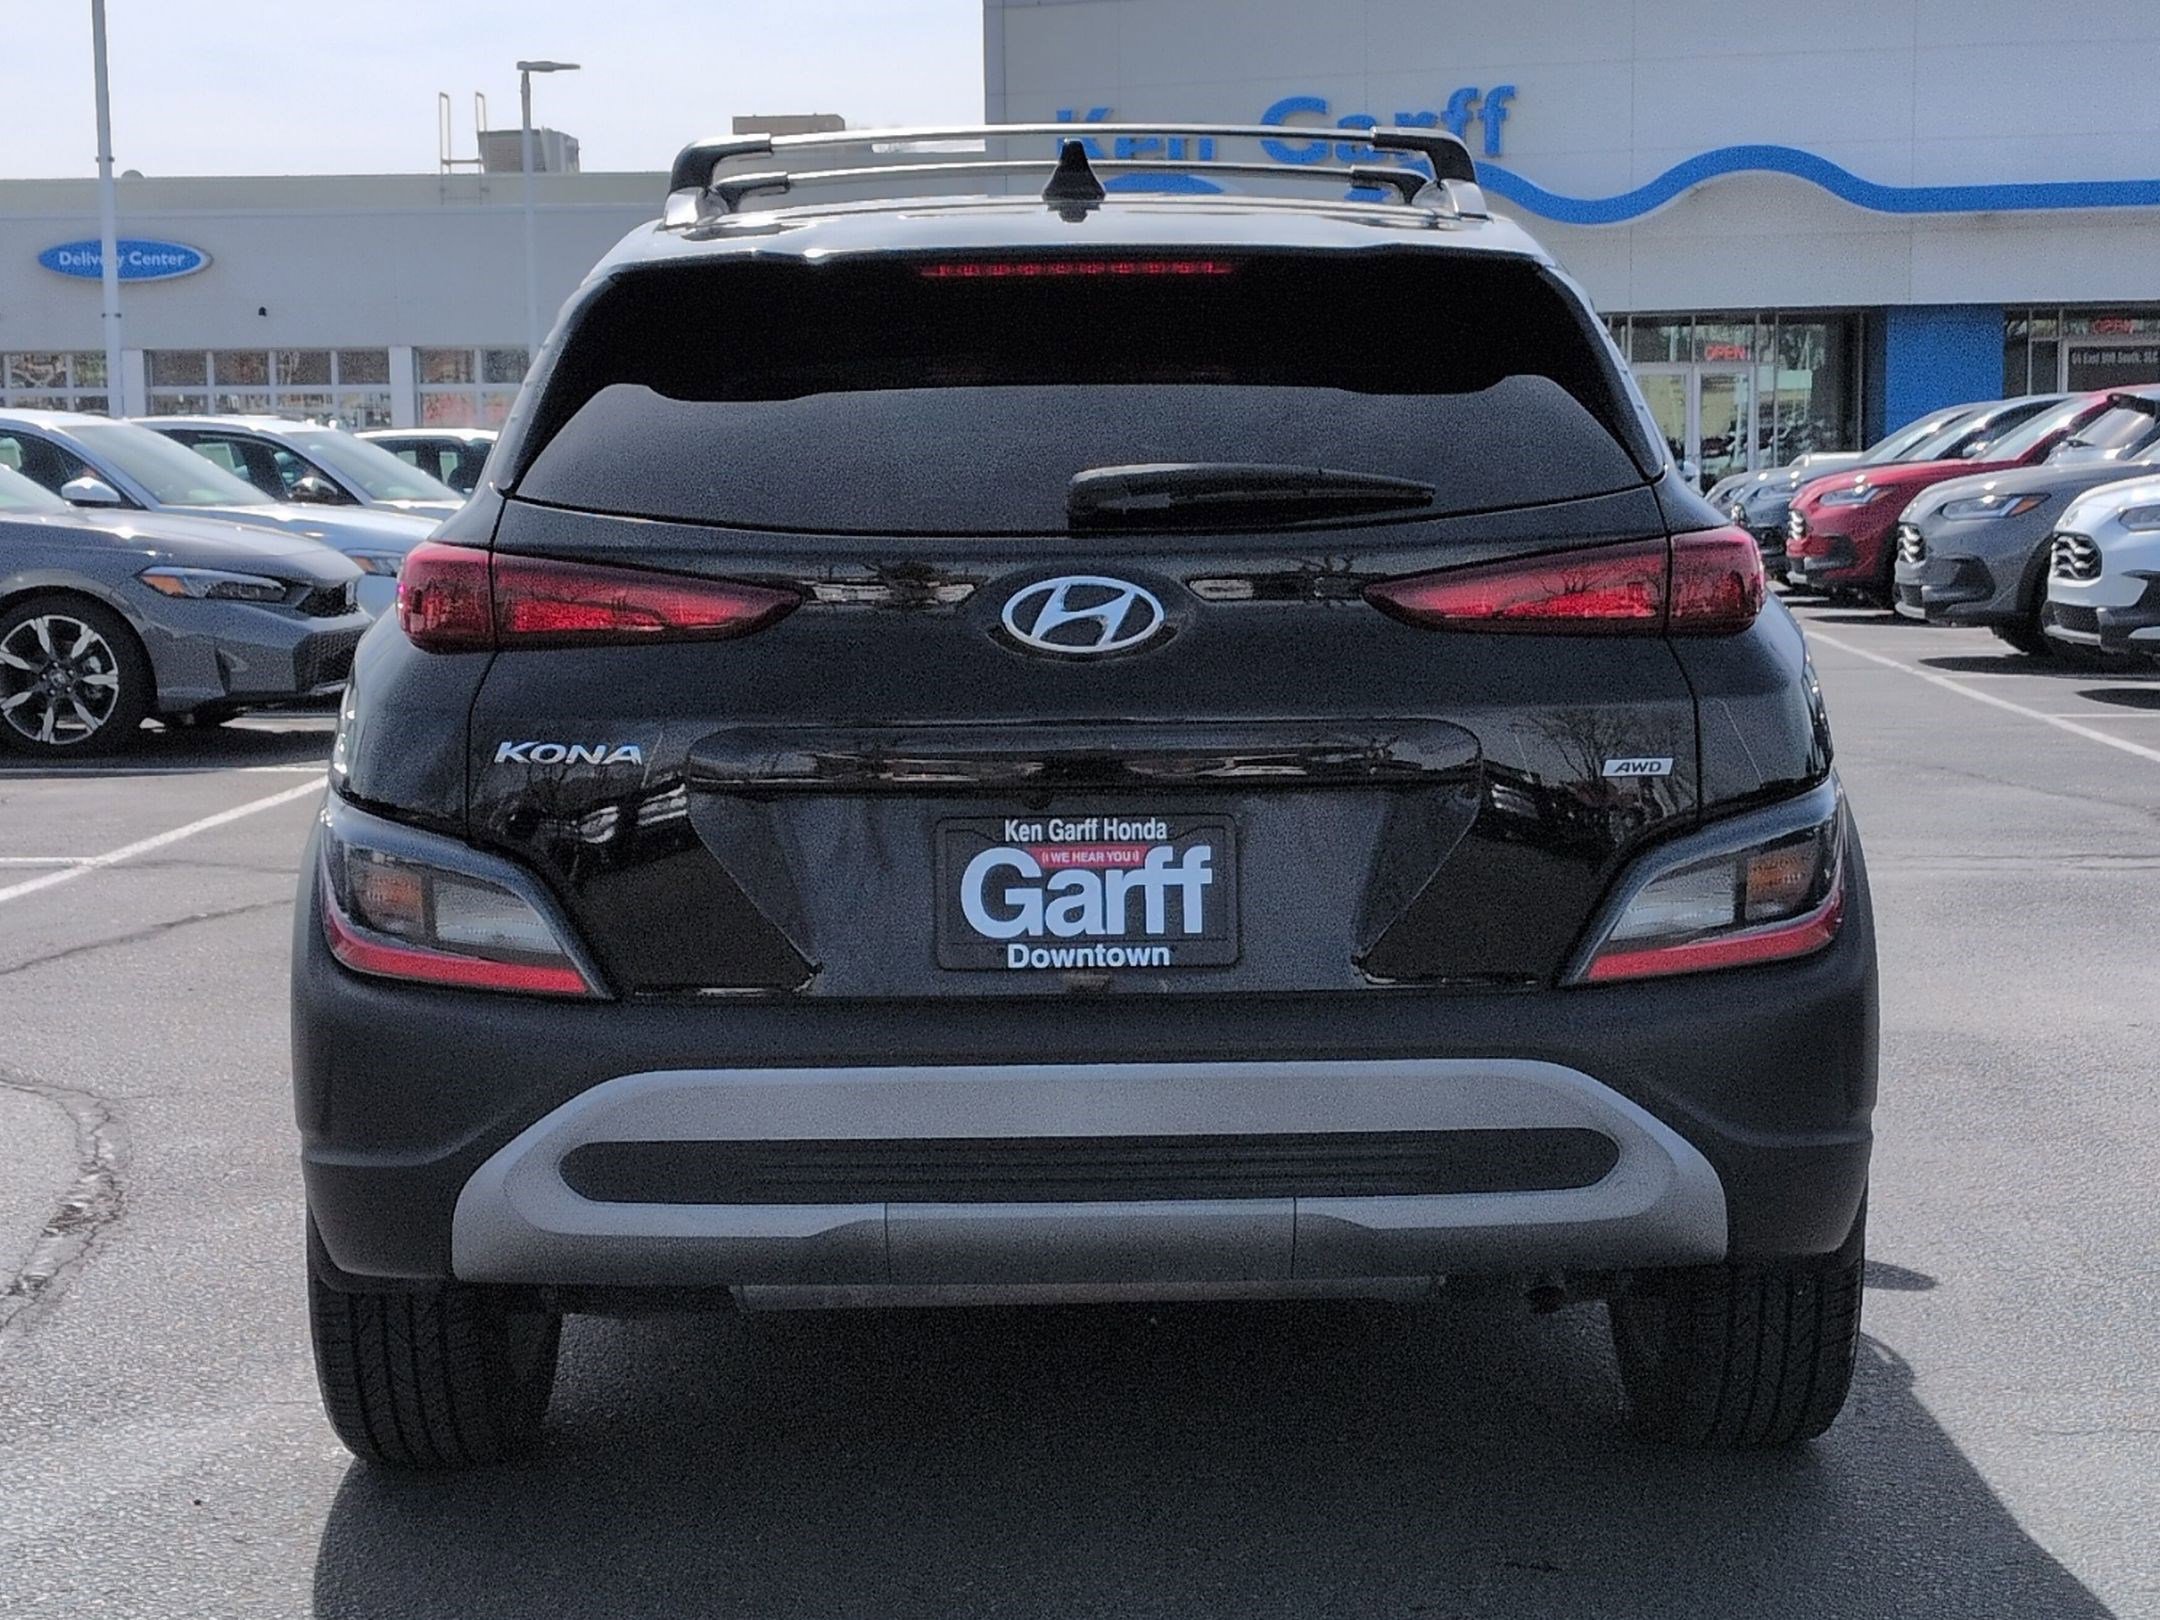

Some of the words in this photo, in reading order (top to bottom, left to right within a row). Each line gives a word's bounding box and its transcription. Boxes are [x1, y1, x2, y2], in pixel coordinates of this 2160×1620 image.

[59, 251, 124, 268] Delivy
[129, 251, 186, 266] Center
[1704, 343, 1746, 361] OPEN
[494, 741, 643, 765] KONA
[1612, 759, 1664, 774] AWD
[1004, 819, 1043, 843] Ken
[1048, 818, 1098, 842] Garff
[1103, 817, 1168, 841] Honda
[1050, 851, 1071, 863] WE
[1072, 851, 1104, 862] HEAR
[1106, 850, 1131, 862] YOU
[960, 845, 1213, 939] Garff
[1007, 943, 1171, 969] Downtown
